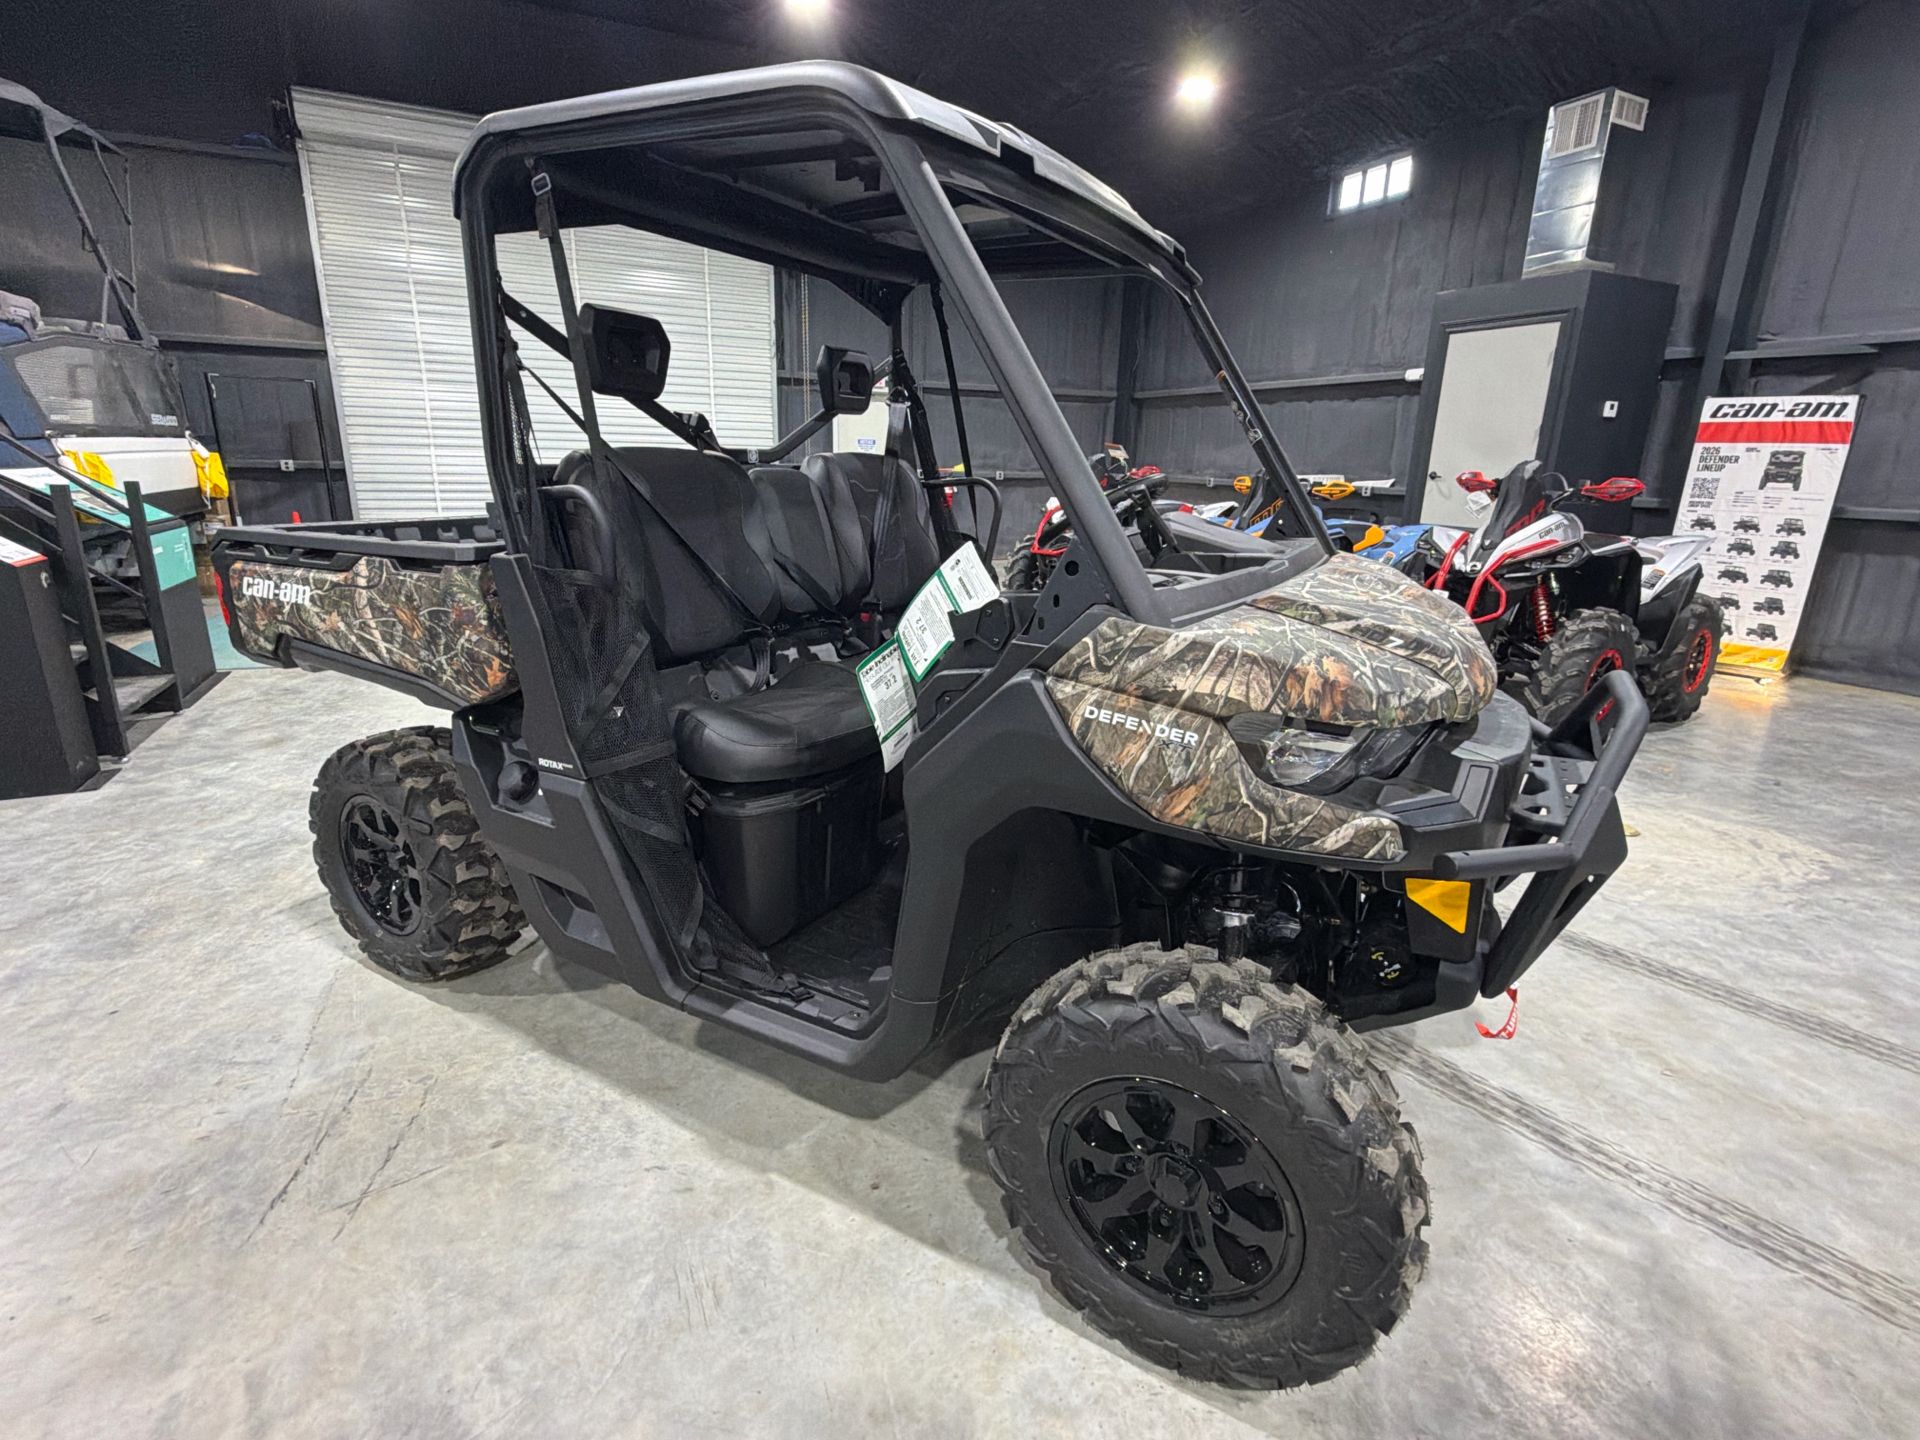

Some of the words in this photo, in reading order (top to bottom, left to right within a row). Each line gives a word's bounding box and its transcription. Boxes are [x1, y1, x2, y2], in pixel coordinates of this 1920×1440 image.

[1709, 401, 1850, 419] can-am
[1698, 455, 1741, 464] DEFENDER
[1696, 464, 1727, 472] LINEUP
[242, 576, 311, 607] can-am
[1084, 705, 1199, 746] DEFENDER
[538, 757, 564, 770] ROTAX
